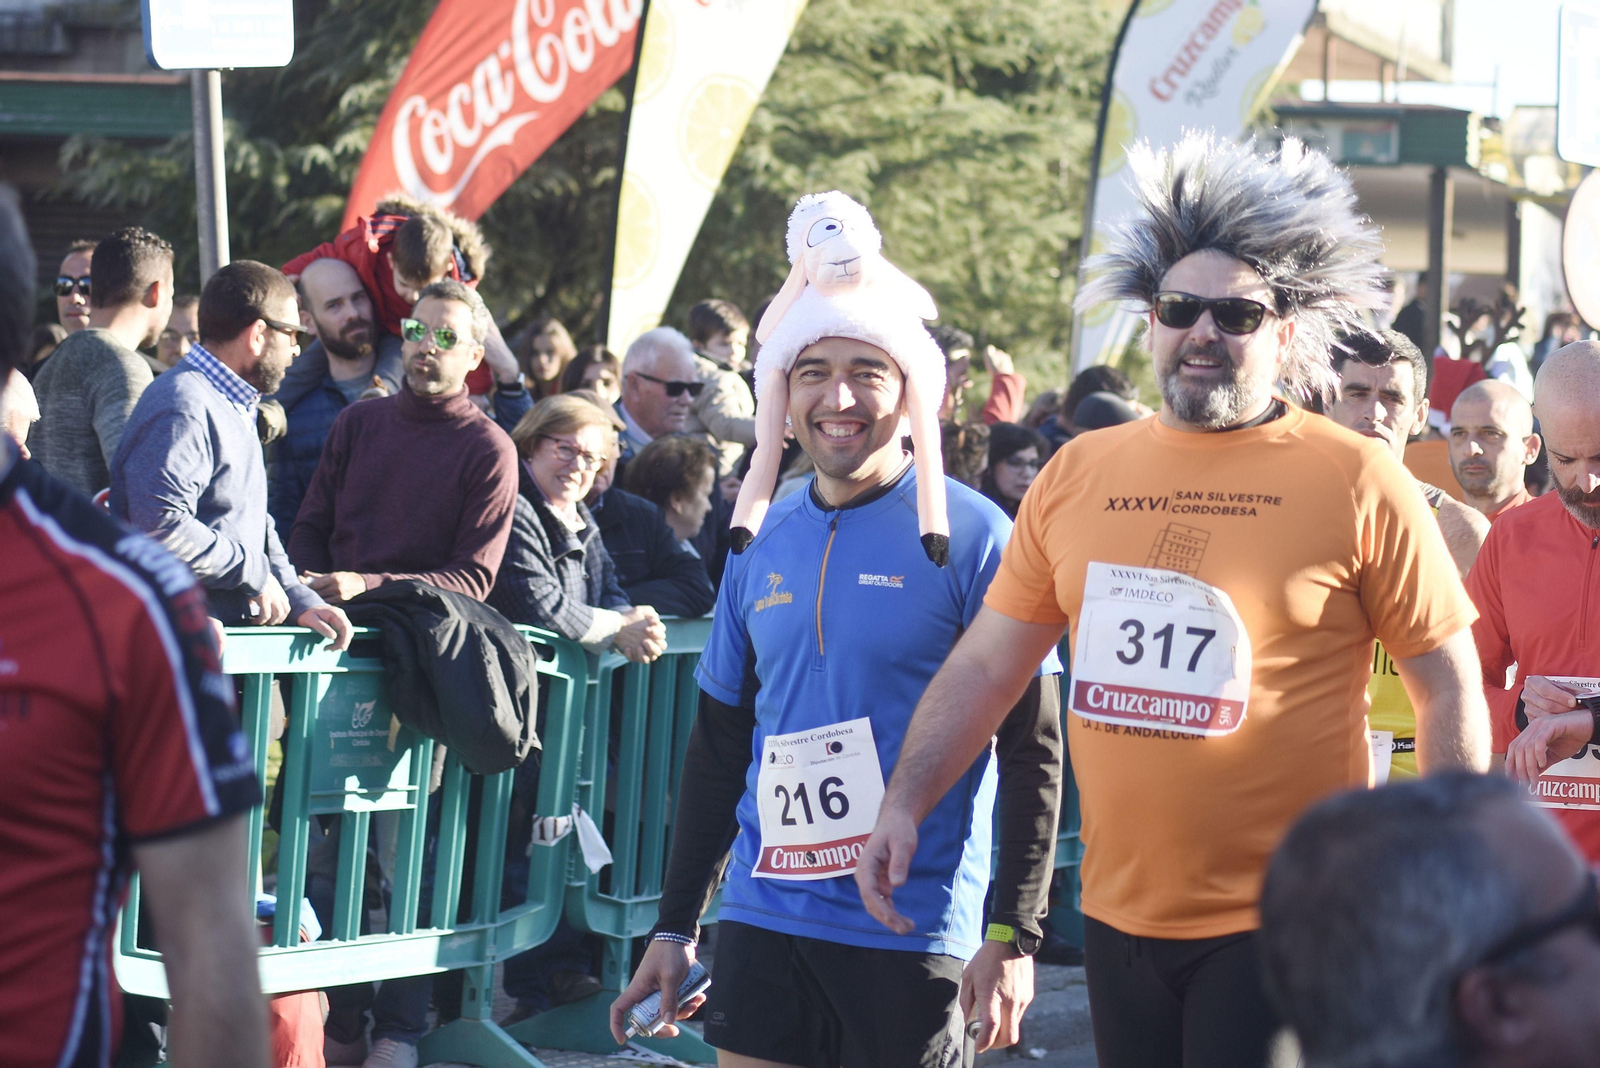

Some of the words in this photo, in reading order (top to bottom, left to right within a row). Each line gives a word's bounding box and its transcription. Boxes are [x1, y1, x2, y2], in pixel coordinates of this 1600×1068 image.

[1104, 496, 1169, 512] XXXVI
[1174, 491, 1204, 502] SAN
[1206, 491, 1283, 506] SILVESTRE
[1171, 504, 1258, 517] CORDOBESA
[859, 573, 888, 582] REGATTA
[874, 581, 903, 589] OUTDOORS
[1124, 587, 1174, 603] IMDECO
[1116, 619, 1217, 673] 317
[1086, 684, 1211, 724] Cruzcampo
[810, 727, 854, 742] Cordobesa
[1104, 723, 1119, 734] DE
[774, 776, 850, 826] 216
